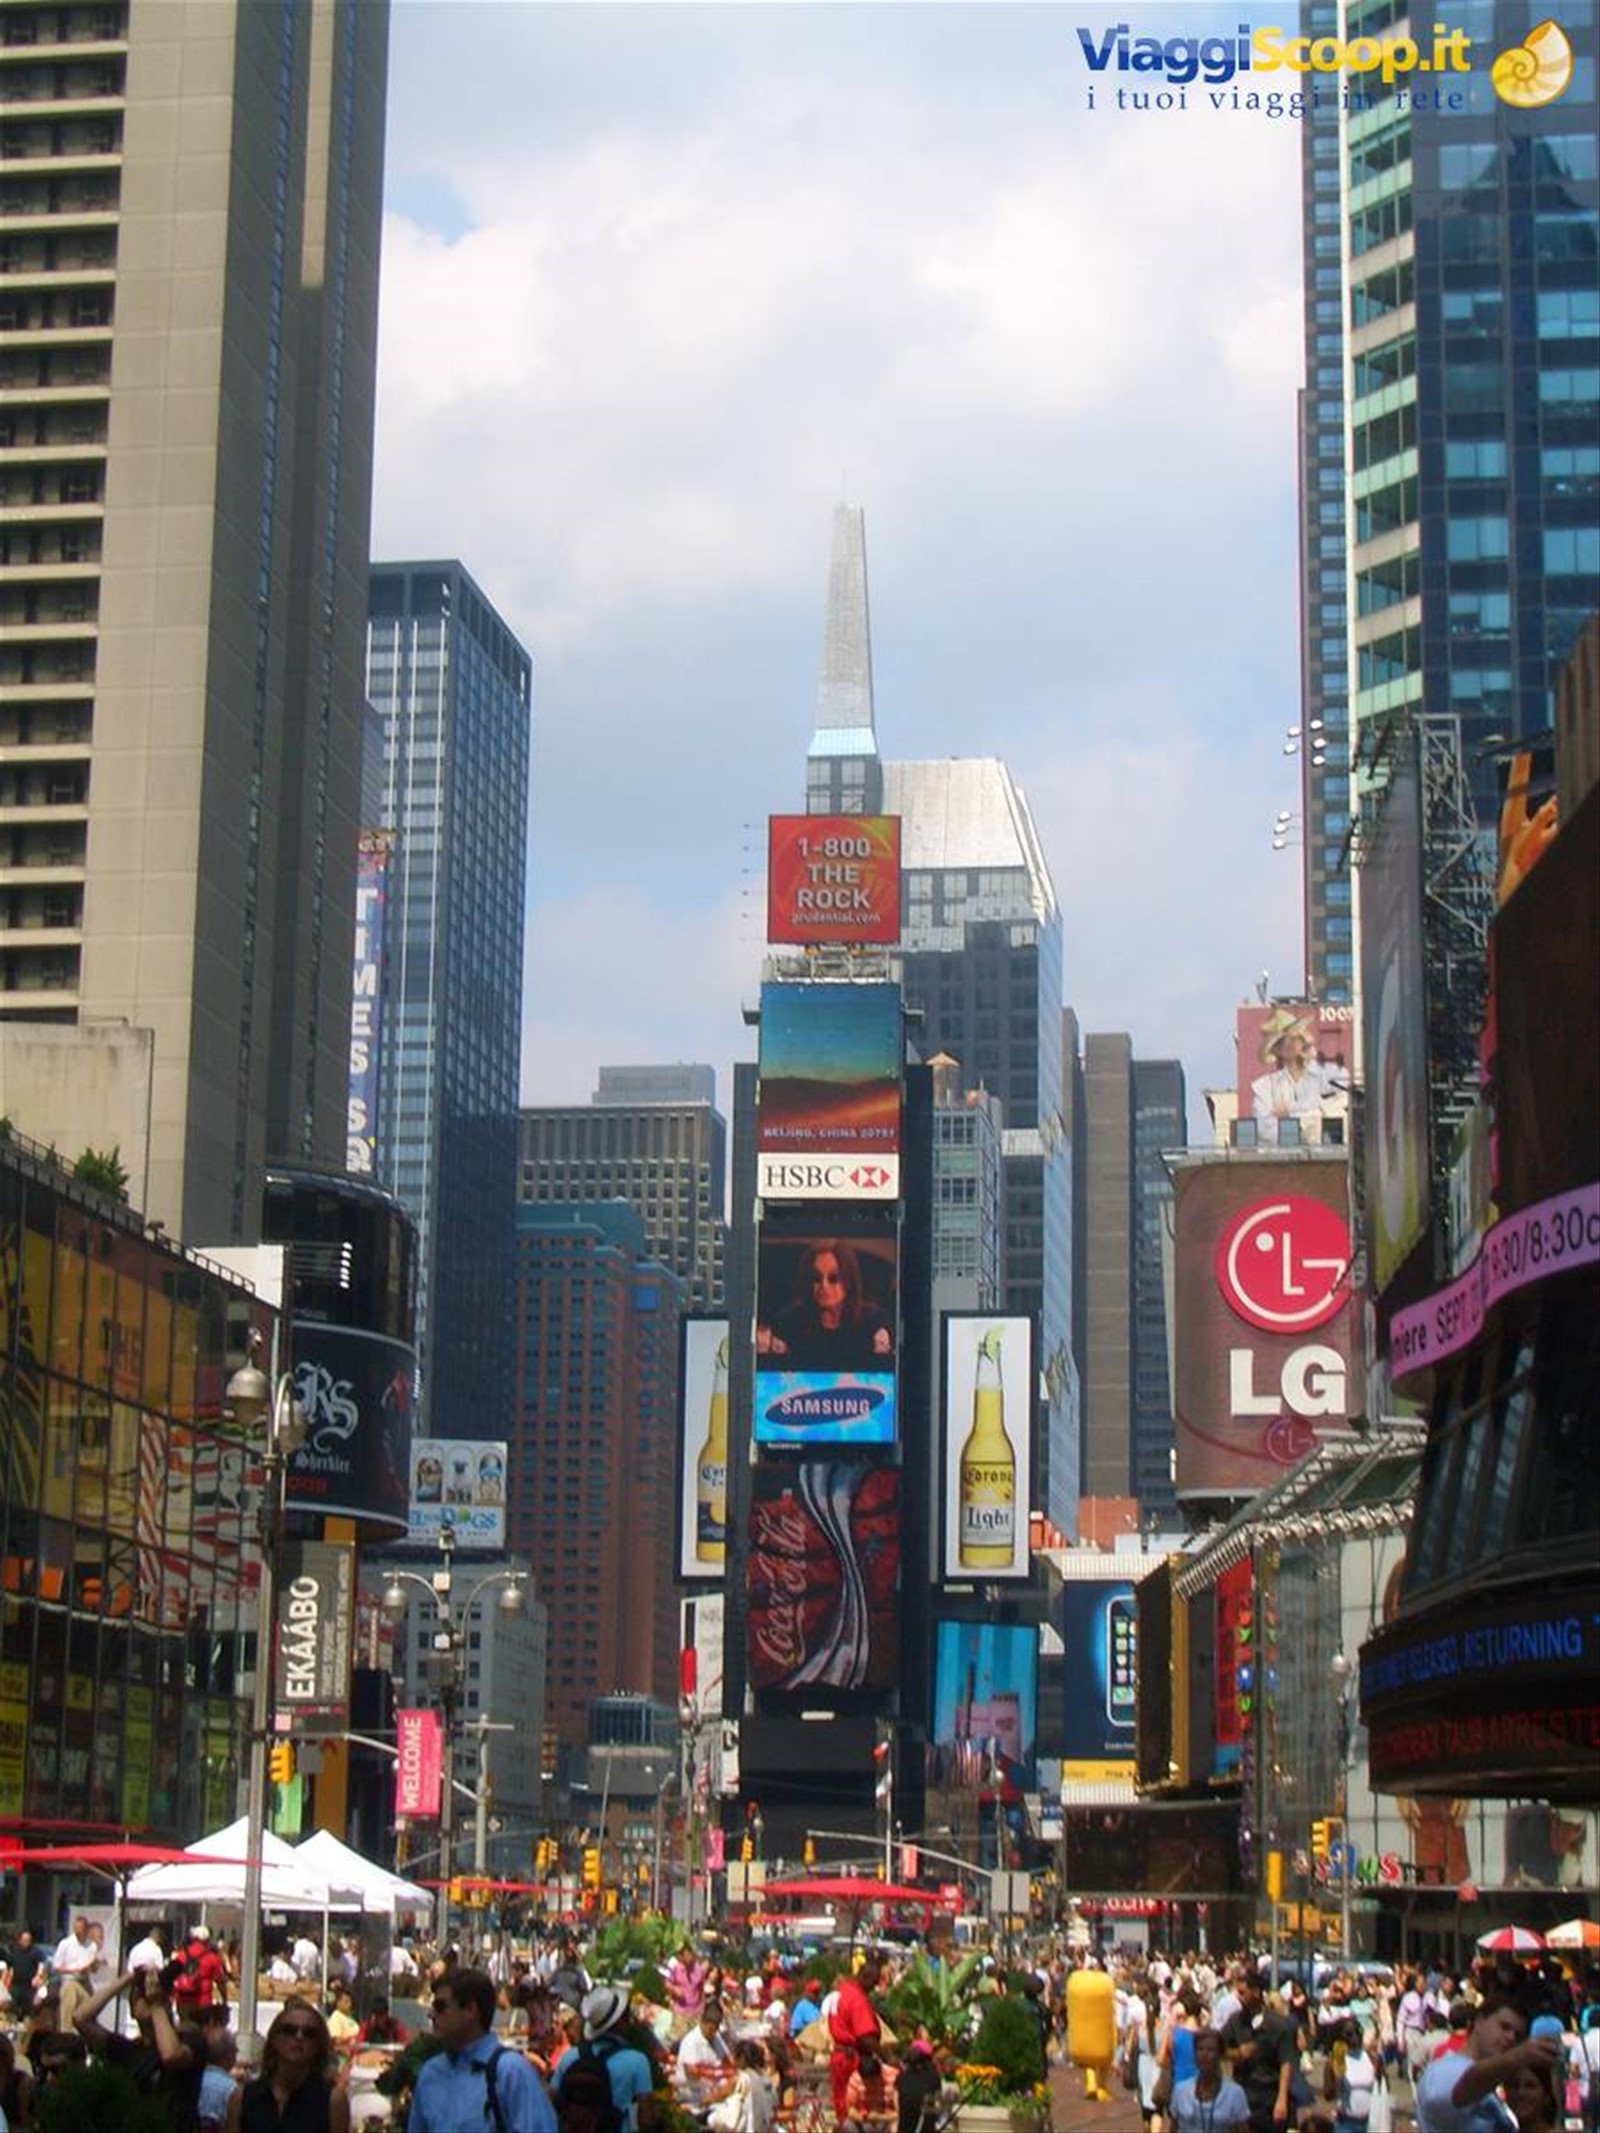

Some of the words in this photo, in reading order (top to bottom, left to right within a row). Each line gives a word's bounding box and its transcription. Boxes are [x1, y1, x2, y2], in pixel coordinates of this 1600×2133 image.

[797, 836, 871, 858] 1-800
[807, 863, 860, 883] THE
[797, 888, 871, 909] ROCK
[767, 1165, 845, 1190] HSBC
[1229, 1344, 1346, 1417] LG
[781, 1399, 870, 1415] SAMSUNG
[966, 1505, 1010, 1531] Light
[1464, 1617, 1583, 1669] RETURNING
[401, 1716, 423, 1810] WELCOME
